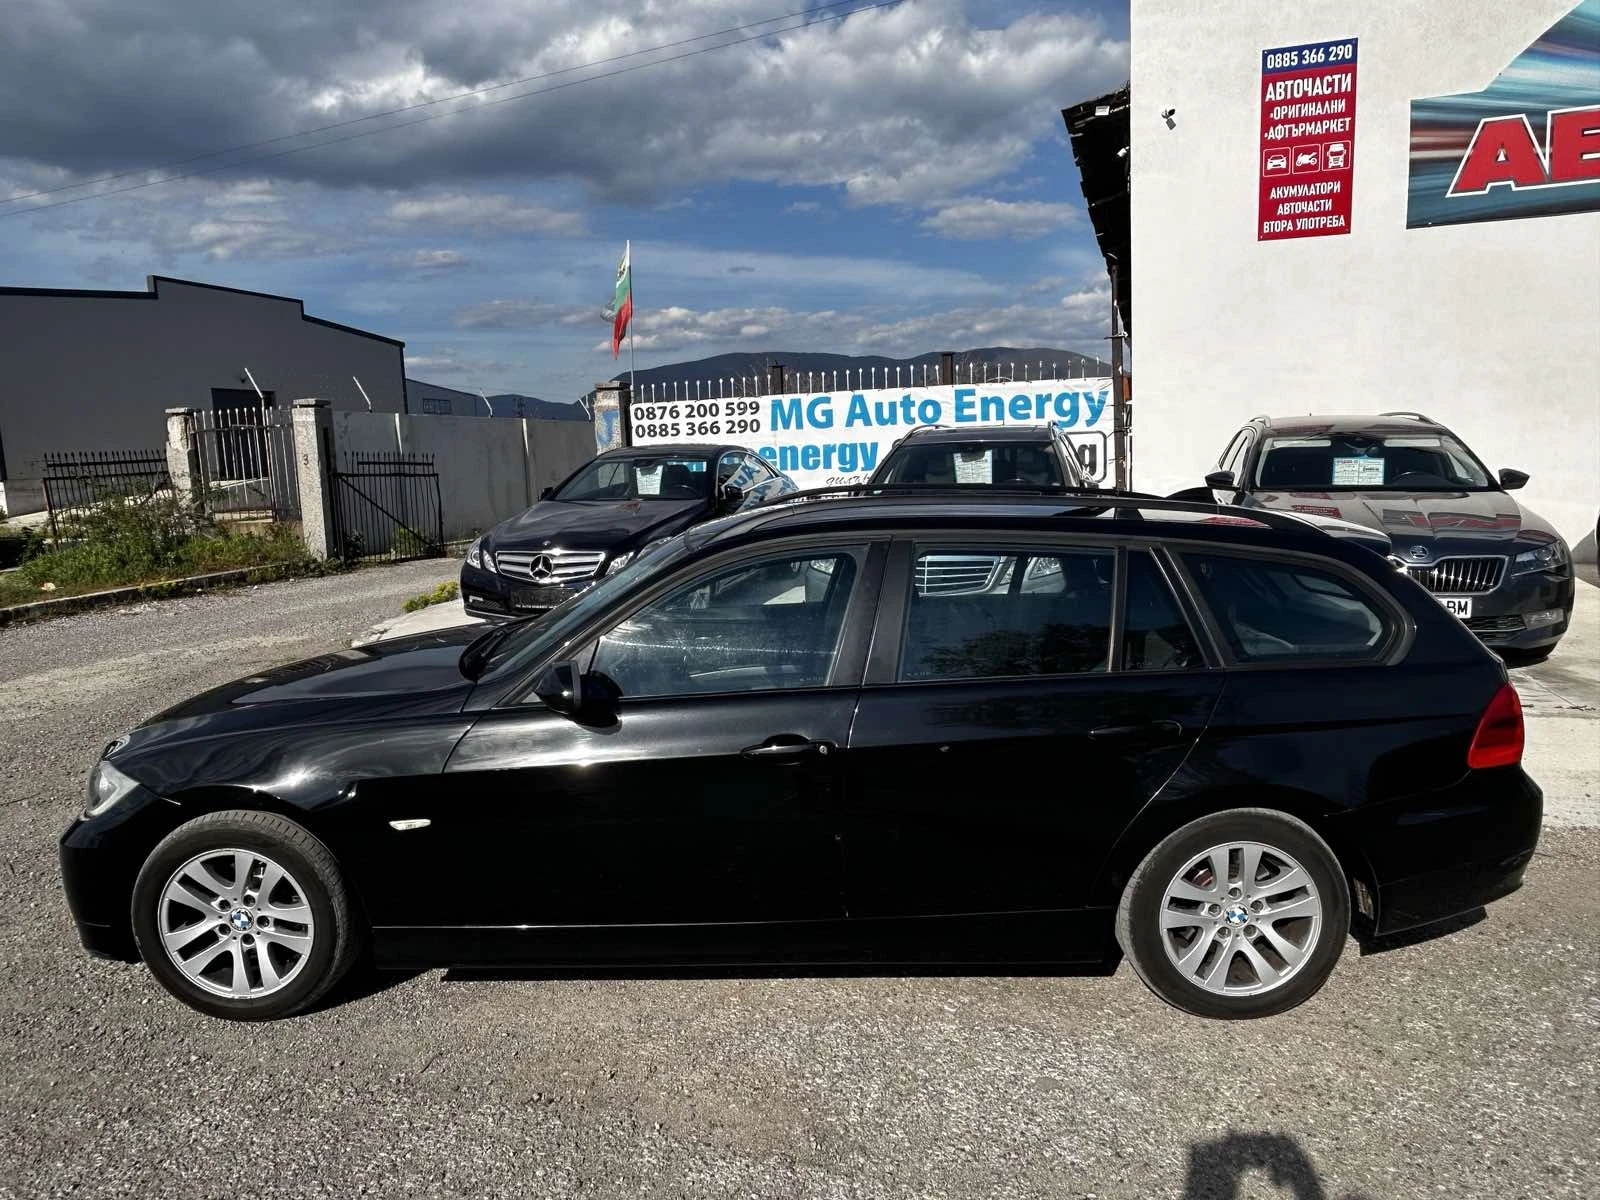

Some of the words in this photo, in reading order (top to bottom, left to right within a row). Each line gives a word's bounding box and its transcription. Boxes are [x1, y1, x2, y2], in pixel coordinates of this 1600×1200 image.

[1267, 51, 1298, 69] 0885
[1302, 47, 1325, 65] 366
[1328, 44, 1353, 62] 290
[1265, 72, 1352, 101] АВТОЧАСТИ
[1270, 180, 1341, 199] АКУМУЛАТОРИ
[1277, 198, 1333, 215] АВТОЧАСТИ
[1263, 217, 1293, 233] ВТОРА
[1296, 214, 1345, 231] УПОТРЕБА
[634, 405, 680, 421] 0876
[685, 403, 720, 419] 200
[724, 401, 761, 417] 599
[771, 394, 833, 431] MG
[845, 392, 942, 428] Auto
[954, 388, 1109, 428] Energy
[635, 422, 681, 438] 0885
[686, 420, 721, 436] 366
[726, 418, 761, 435] 290
